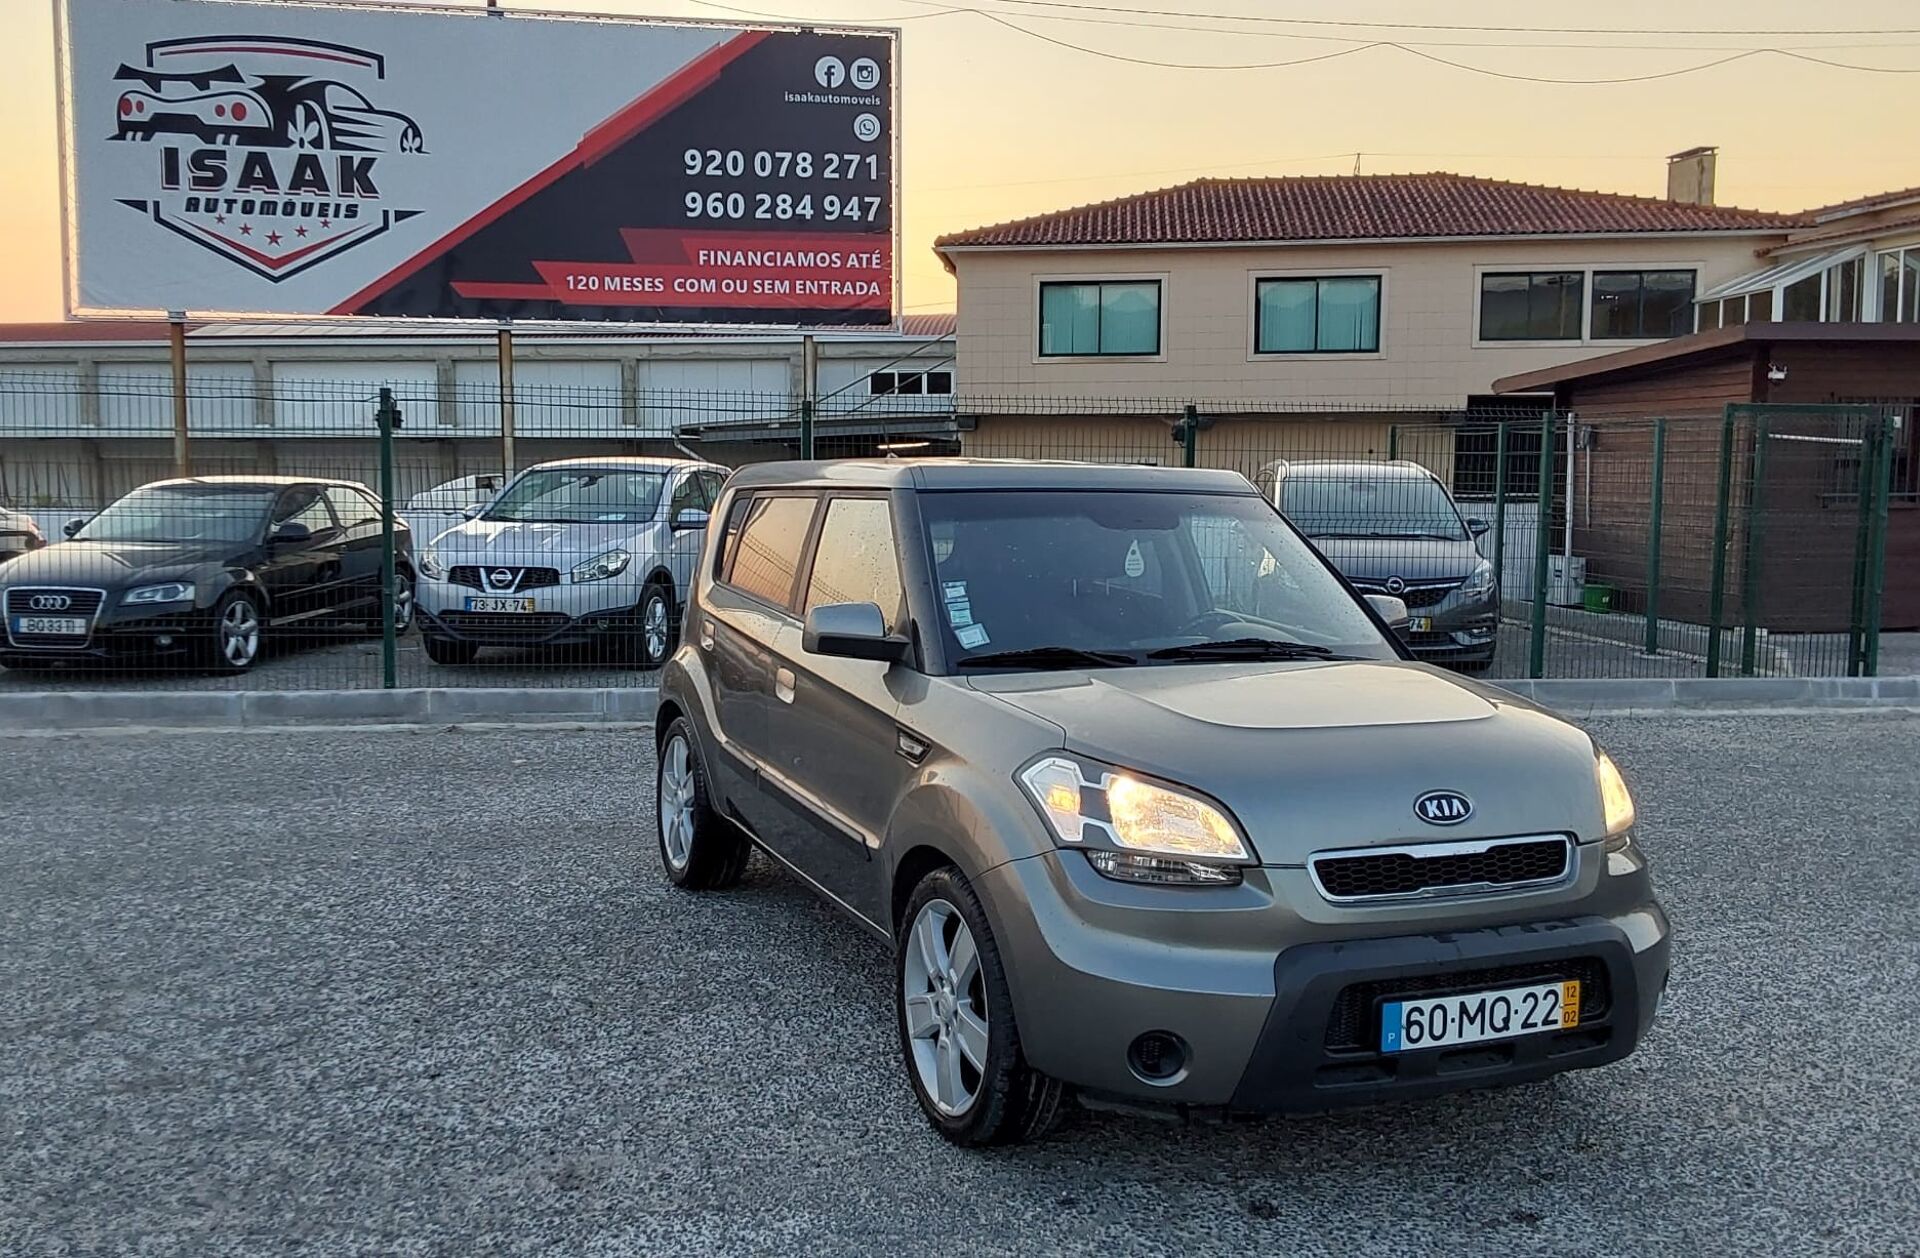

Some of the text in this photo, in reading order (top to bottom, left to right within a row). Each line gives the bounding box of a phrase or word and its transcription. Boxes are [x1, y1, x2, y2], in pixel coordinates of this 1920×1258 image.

[784, 91, 881, 105] isaakautomoveis
[160, 147, 380, 198] ISAAK
[684, 149, 878, 180] 920 078 271
[684, 191, 881, 222] 960 284 947
[699, 249, 881, 269] FINANCIAMOS ATÉ
[566, 275, 881, 296] 120 MESES COM OU SEM ENTRADA
[1424, 798, 1466, 818] KIA
[1566, 985, 1577, 998] 12
[1563, 1010, 1577, 1024] 02
[1387, 1032, 1395, 1043] P
